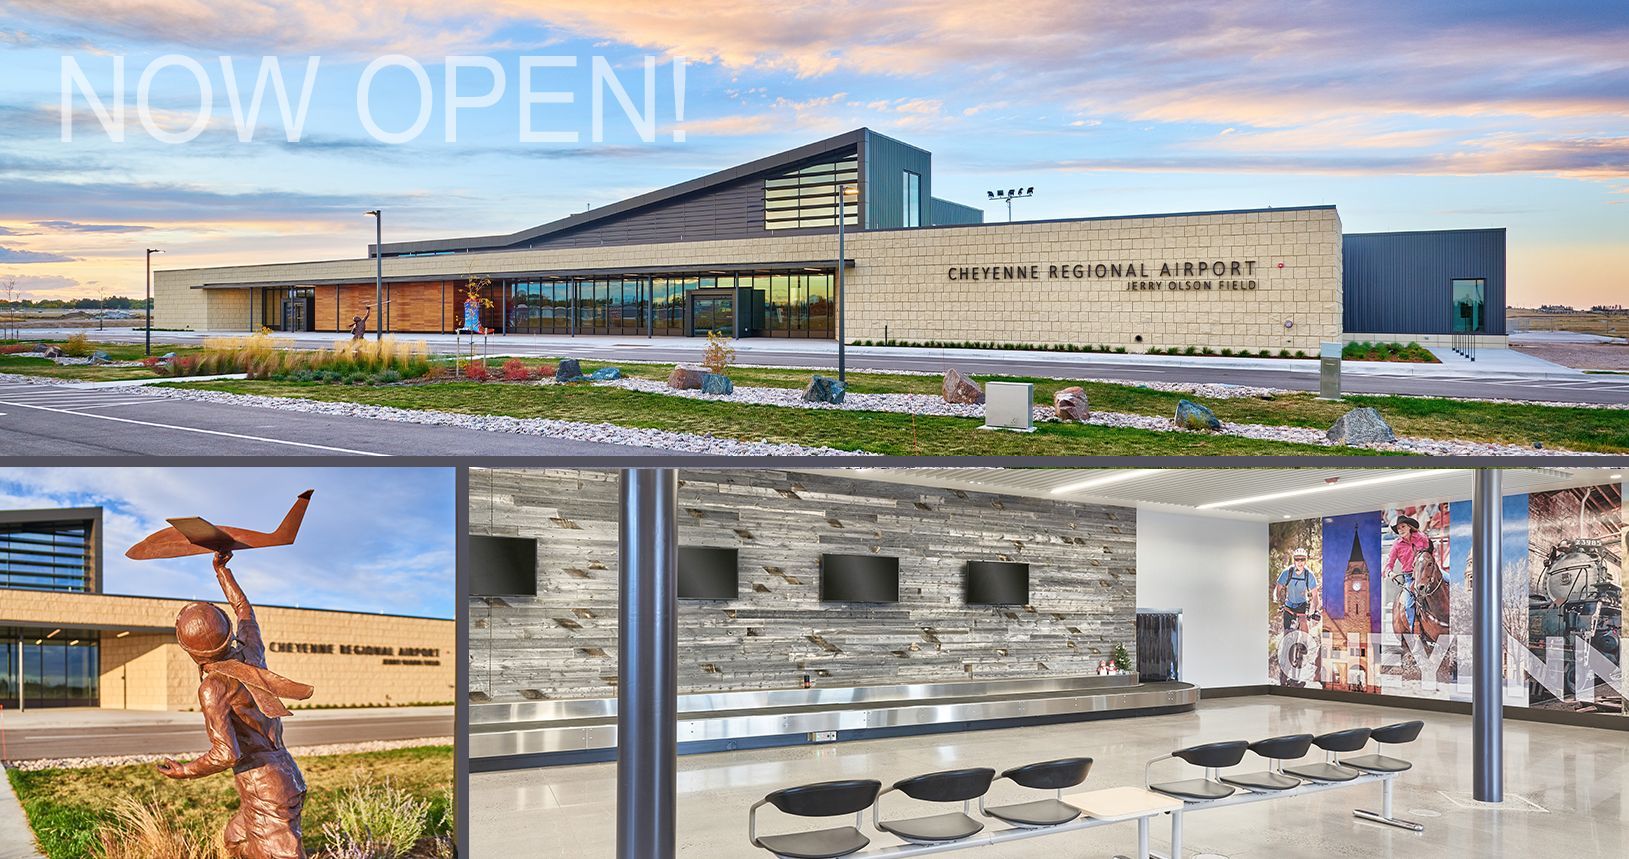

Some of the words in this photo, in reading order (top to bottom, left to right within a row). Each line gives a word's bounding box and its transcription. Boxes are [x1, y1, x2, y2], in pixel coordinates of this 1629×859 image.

[948, 265, 1039, 281] CHEYENNE
[1049, 262, 1149, 279] REGIONAL
[1160, 260, 1256, 277] AIRPORT
[1126, 280, 1162, 291] JERRY
[1168, 280, 1212, 291] OLSON
[1219, 280, 1257, 291] FIELD
